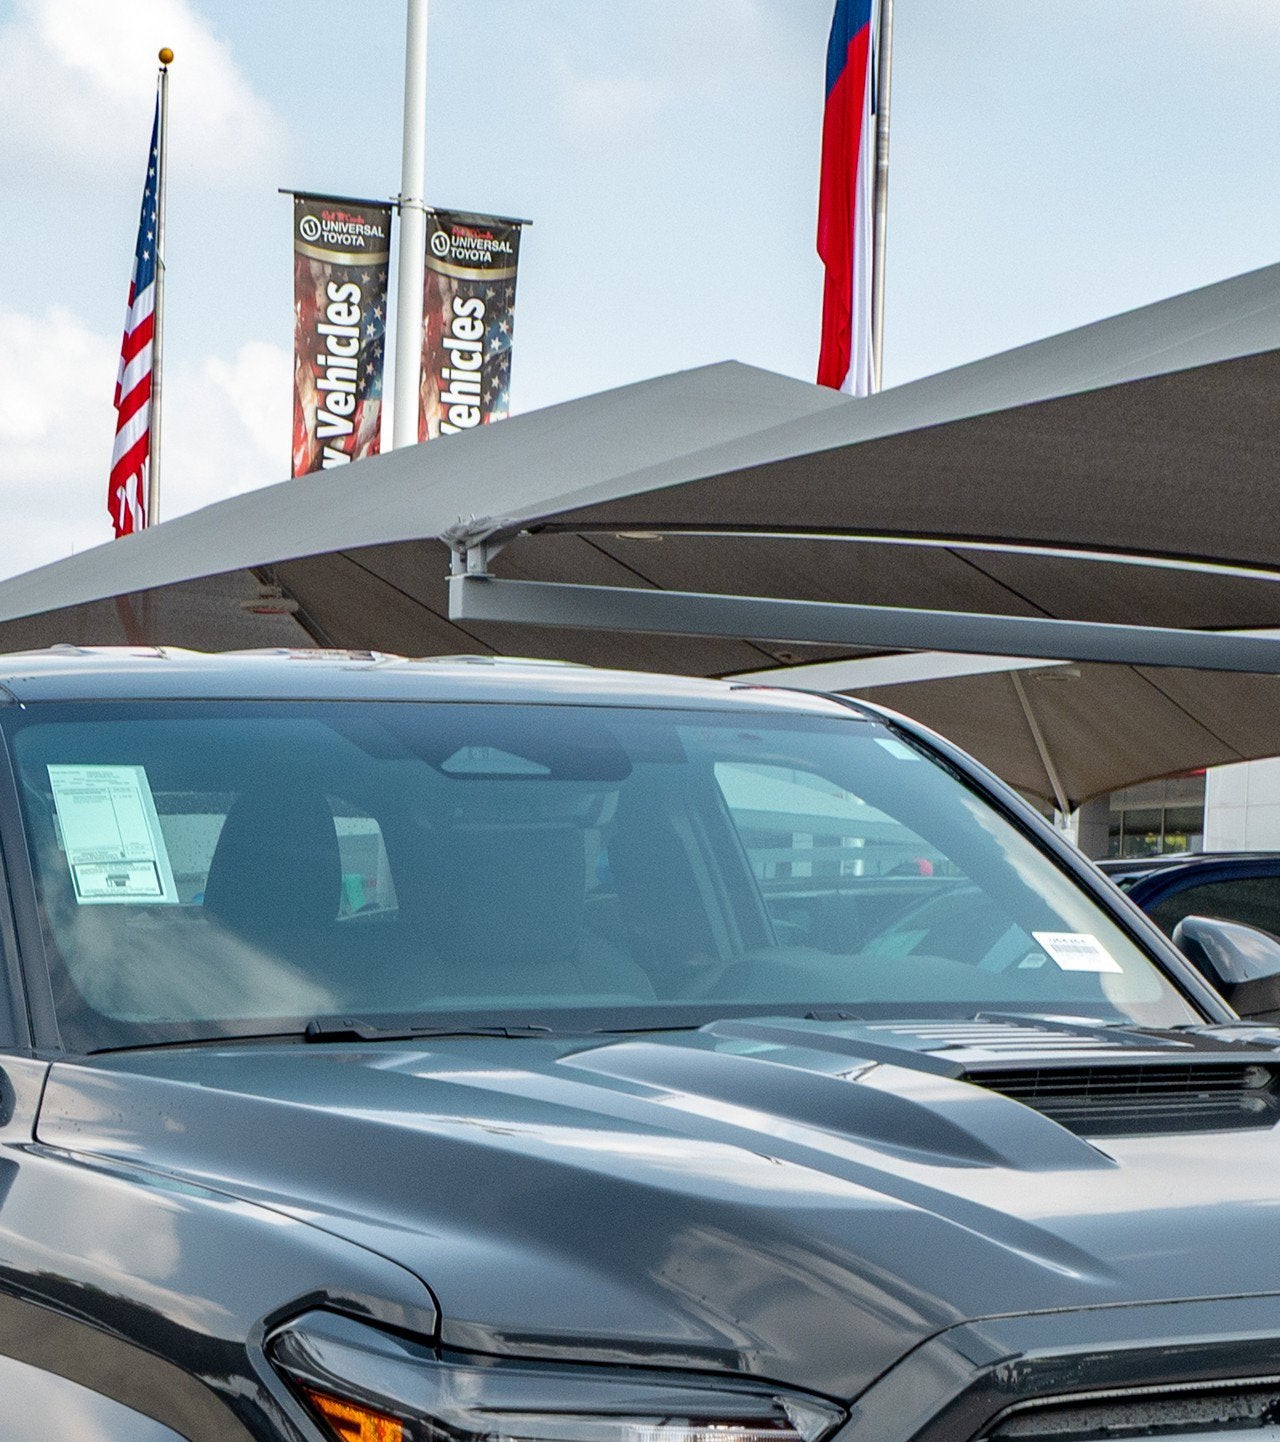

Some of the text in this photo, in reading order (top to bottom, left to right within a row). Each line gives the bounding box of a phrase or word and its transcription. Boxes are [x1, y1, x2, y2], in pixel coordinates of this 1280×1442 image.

[321, 219, 385, 238] UNIVERSAL
[321, 231, 365, 247] TOYOTA
[451, 236, 513, 253] UNIVERSAL
[450, 247, 492, 263] TOYOTA
[316, 280, 362, 438] Vehicles
